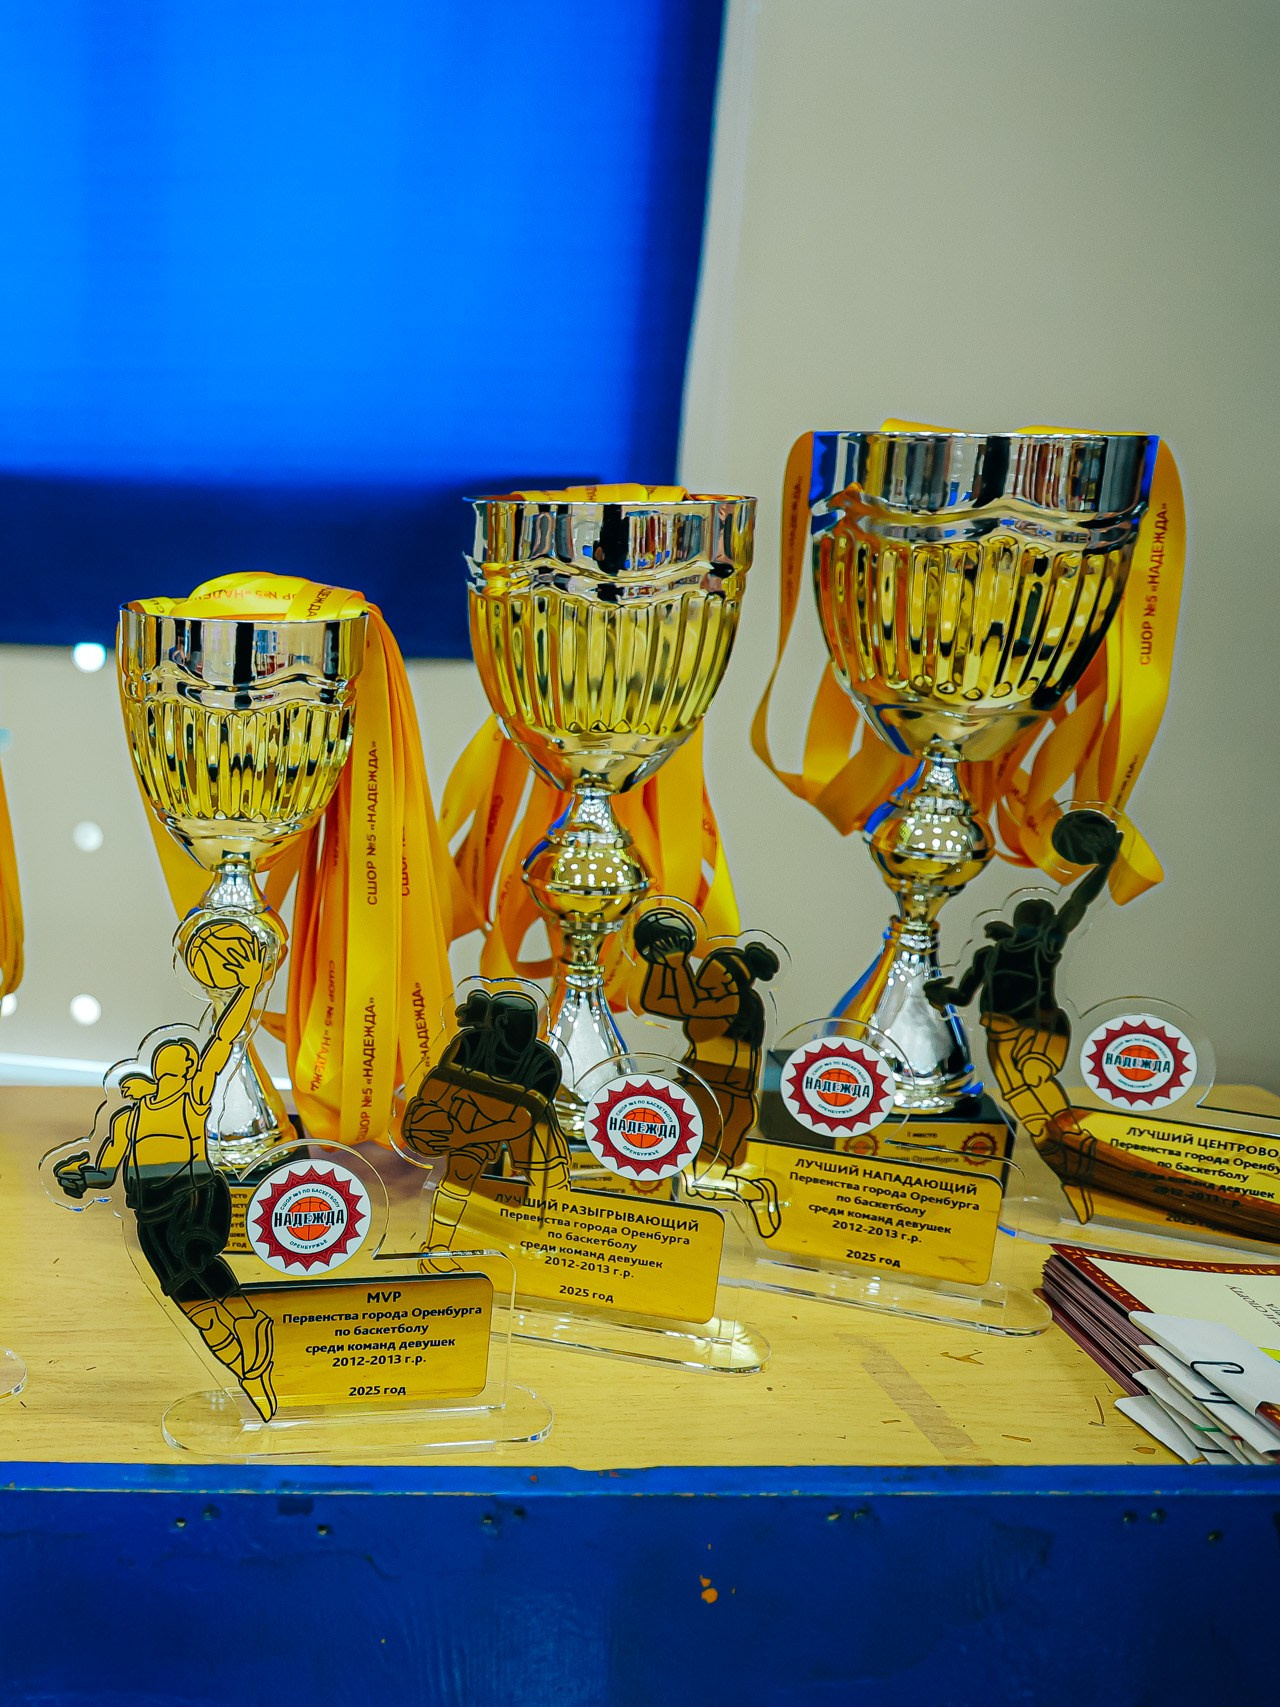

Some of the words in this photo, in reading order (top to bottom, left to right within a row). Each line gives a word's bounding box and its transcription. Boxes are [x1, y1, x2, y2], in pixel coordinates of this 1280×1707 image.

[1148, 502, 1169, 592] «НАДЕЖДА»
[255, 589, 277, 599] №5
[1144, 595, 1157, 617] №5
[1140, 620, 1153, 665] СШОР
[366, 740, 378, 833] «НАДЕЖДА»
[367, 834, 377, 856] №5
[367, 861, 378, 905] СШОР
[362, 997, 377, 1084] «НАДЕЖДА»
[1105, 1052, 1171, 1073] НАДЕЖДА
[361, 1088, 373, 1108] №5
[805, 1076, 870, 1098] НАДЕЖДА
[609, 1116, 677, 1139] НАДЕЖДА
[1127, 1127, 1194, 1144] ЛУЧШИЙ
[1197, 1138, 1280, 1158] ЦЕНТРОВО
[1110, 1138, 1182, 1157] Первенства
[1184, 1151, 1230, 1166] города
[1232, 1157, 1280, 1174] Оренбу
[795, 1158, 860, 1177] ЛУЧШИЙ
[862, 1168, 978, 1196] НАПАДАЮЩИЙ
[1157, 1159, 1172, 1168] по
[1175, 1161, 1249, 1183] баскетболу
[280, 1196, 292, 1210] СШОР
[311, 1188, 340, 1208] БАСКЕТБОЛУ
[789, 1172, 860, 1192] Первенства
[863, 1184, 907, 1200] города
[910, 1190, 980, 1211] Оренбурга
[1219, 1181, 1275, 1199] девушек
[496, 1193, 558, 1212] ЛУЧШИЙ
[561, 1203, 700, 1233] РАЗЫГРЫВАЮЩИЙ
[836, 1194, 852, 1203] по
[854, 1196, 927, 1217] баскетболу
[274, 1209, 345, 1228] НАДЕЖДА
[499, 1208, 571, 1227] Первенства
[573, 1220, 618, 1236] города
[621, 1227, 690, 1245] Оренбурга
[808, 1203, 846, 1218] среди
[847, 1210, 893, 1226] команд
[895, 1217, 952, 1234] девушек
[547, 1231, 563, 1240] по
[565, 1232, 638, 1253] баскетболу
[832, 1220, 899, 1240] 2012-2013
[901, 1232, 923, 1244] г.р.
[289, 1239, 328, 1250] ОРЕНБУРЖЬЕ
[520, 1240, 557, 1254] среди
[559, 1246, 605, 1262] команд
[608, 1253, 664, 1270] девушек
[544, 1256, 610, 1275] 2012-2013
[613, 1268, 635, 1279] г.р.
[846, 1249, 877, 1262] 2025
[879, 1256, 901, 1269] год
[367, 1291, 402, 1304] MVP
[558, 1285, 590, 1298] 2025
[592, 1292, 615, 1304] год
[282, 1313, 359, 1324] Первенства
[361, 1309, 408, 1321] города
[411, 1305, 482, 1320] Оренбурга
[334, 1328, 350, 1337] по
[353, 1323, 429, 1337] баскетболу
[305, 1344, 344, 1355] среди
[347, 1341, 396, 1352] команд
[399, 1337, 455, 1351] девушек
[332, 1355, 402, 1367] 2012-2013
[405, 1356, 427, 1366] г.р.
[348, 1385, 381, 1396] 2025
[384, 1385, 407, 1396] год
